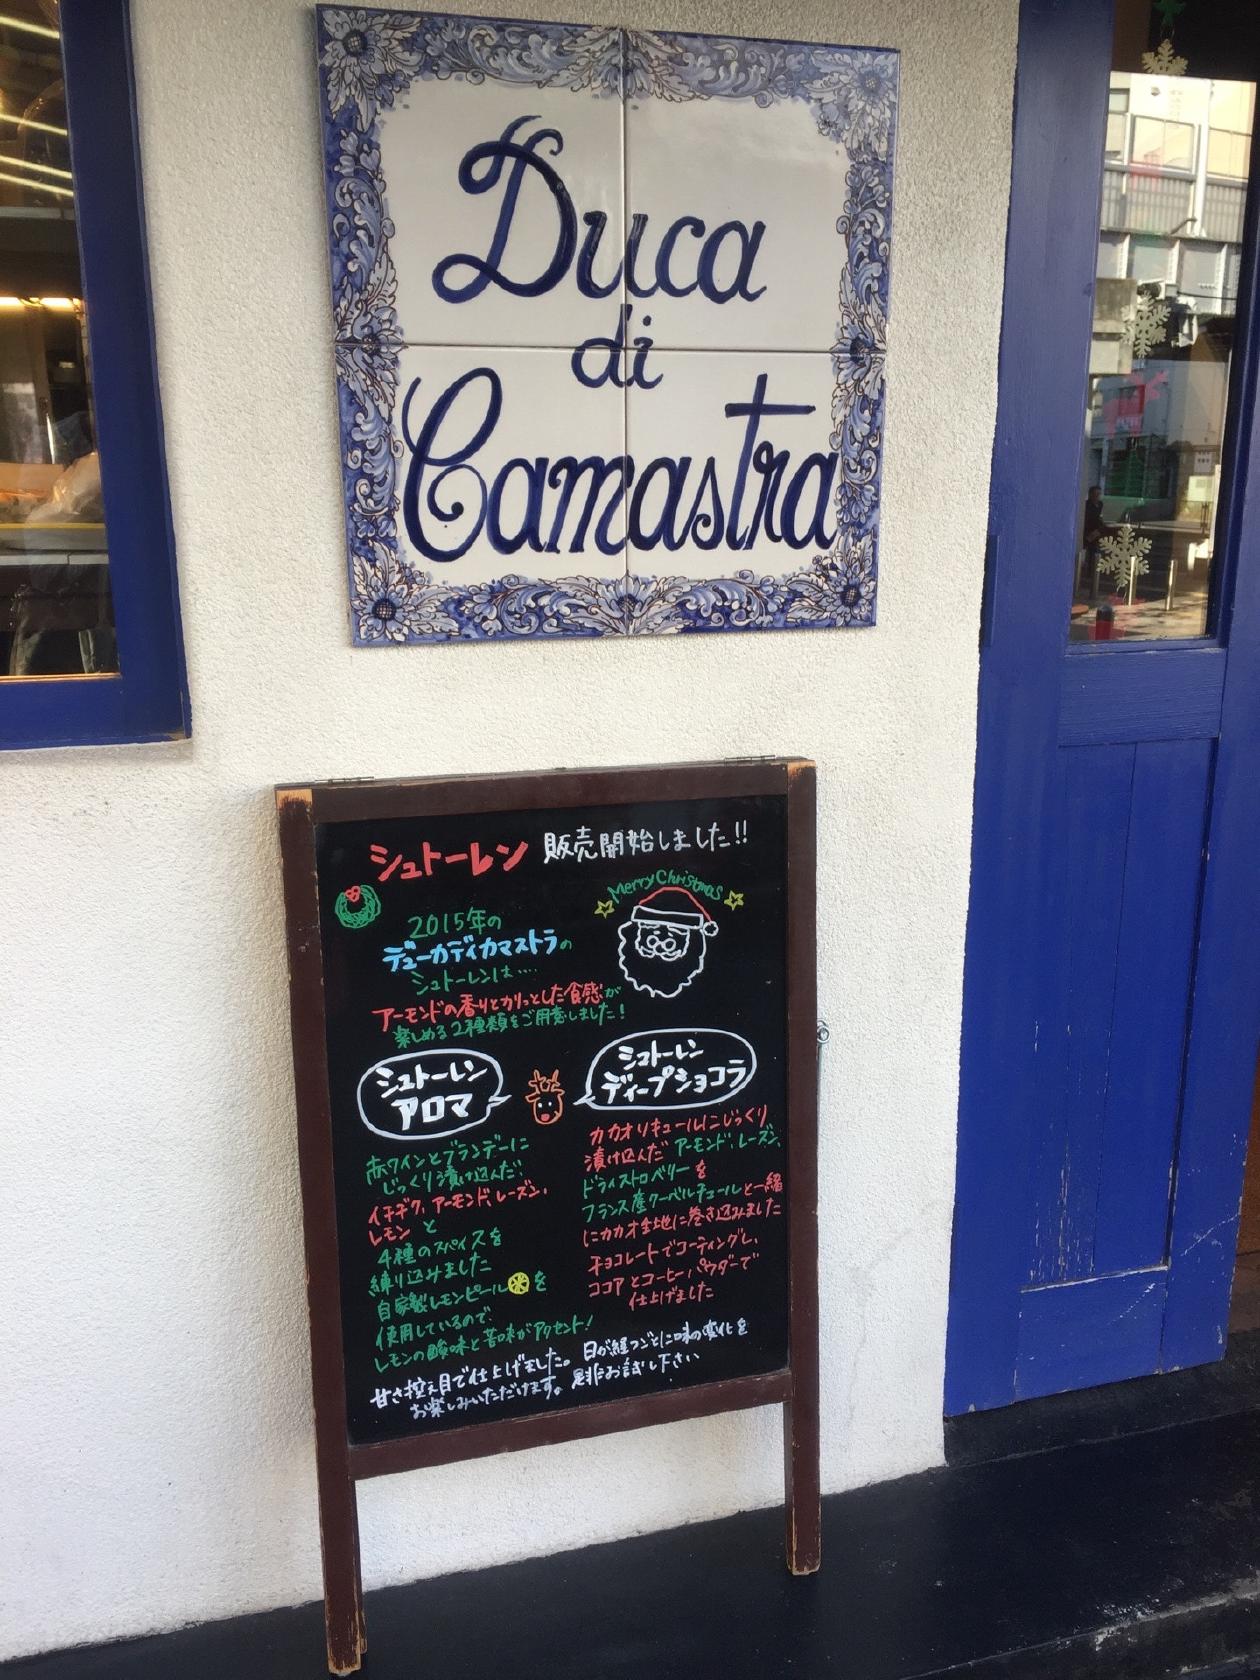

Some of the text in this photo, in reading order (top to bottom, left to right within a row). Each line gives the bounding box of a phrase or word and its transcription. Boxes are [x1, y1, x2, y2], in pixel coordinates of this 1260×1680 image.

[432, 115, 767, 304] Duca
[571, 303, 663, 389] di
[402, 367, 840, 562] Camastra
[370, 841, 528, 881] シュトーレン
[607, 869, 723, 904] Merry Christmas
[408, 906, 502, 939] 2015年の
[618, 1039, 704, 1070] シュトーレン
[375, 1059, 488, 1098] シュトーレン
[601, 1059, 747, 1104] ディープショコラ
[391, 1093, 473, 1131] アロマ
[629, 1281, 715, 1311] 仕上げました
